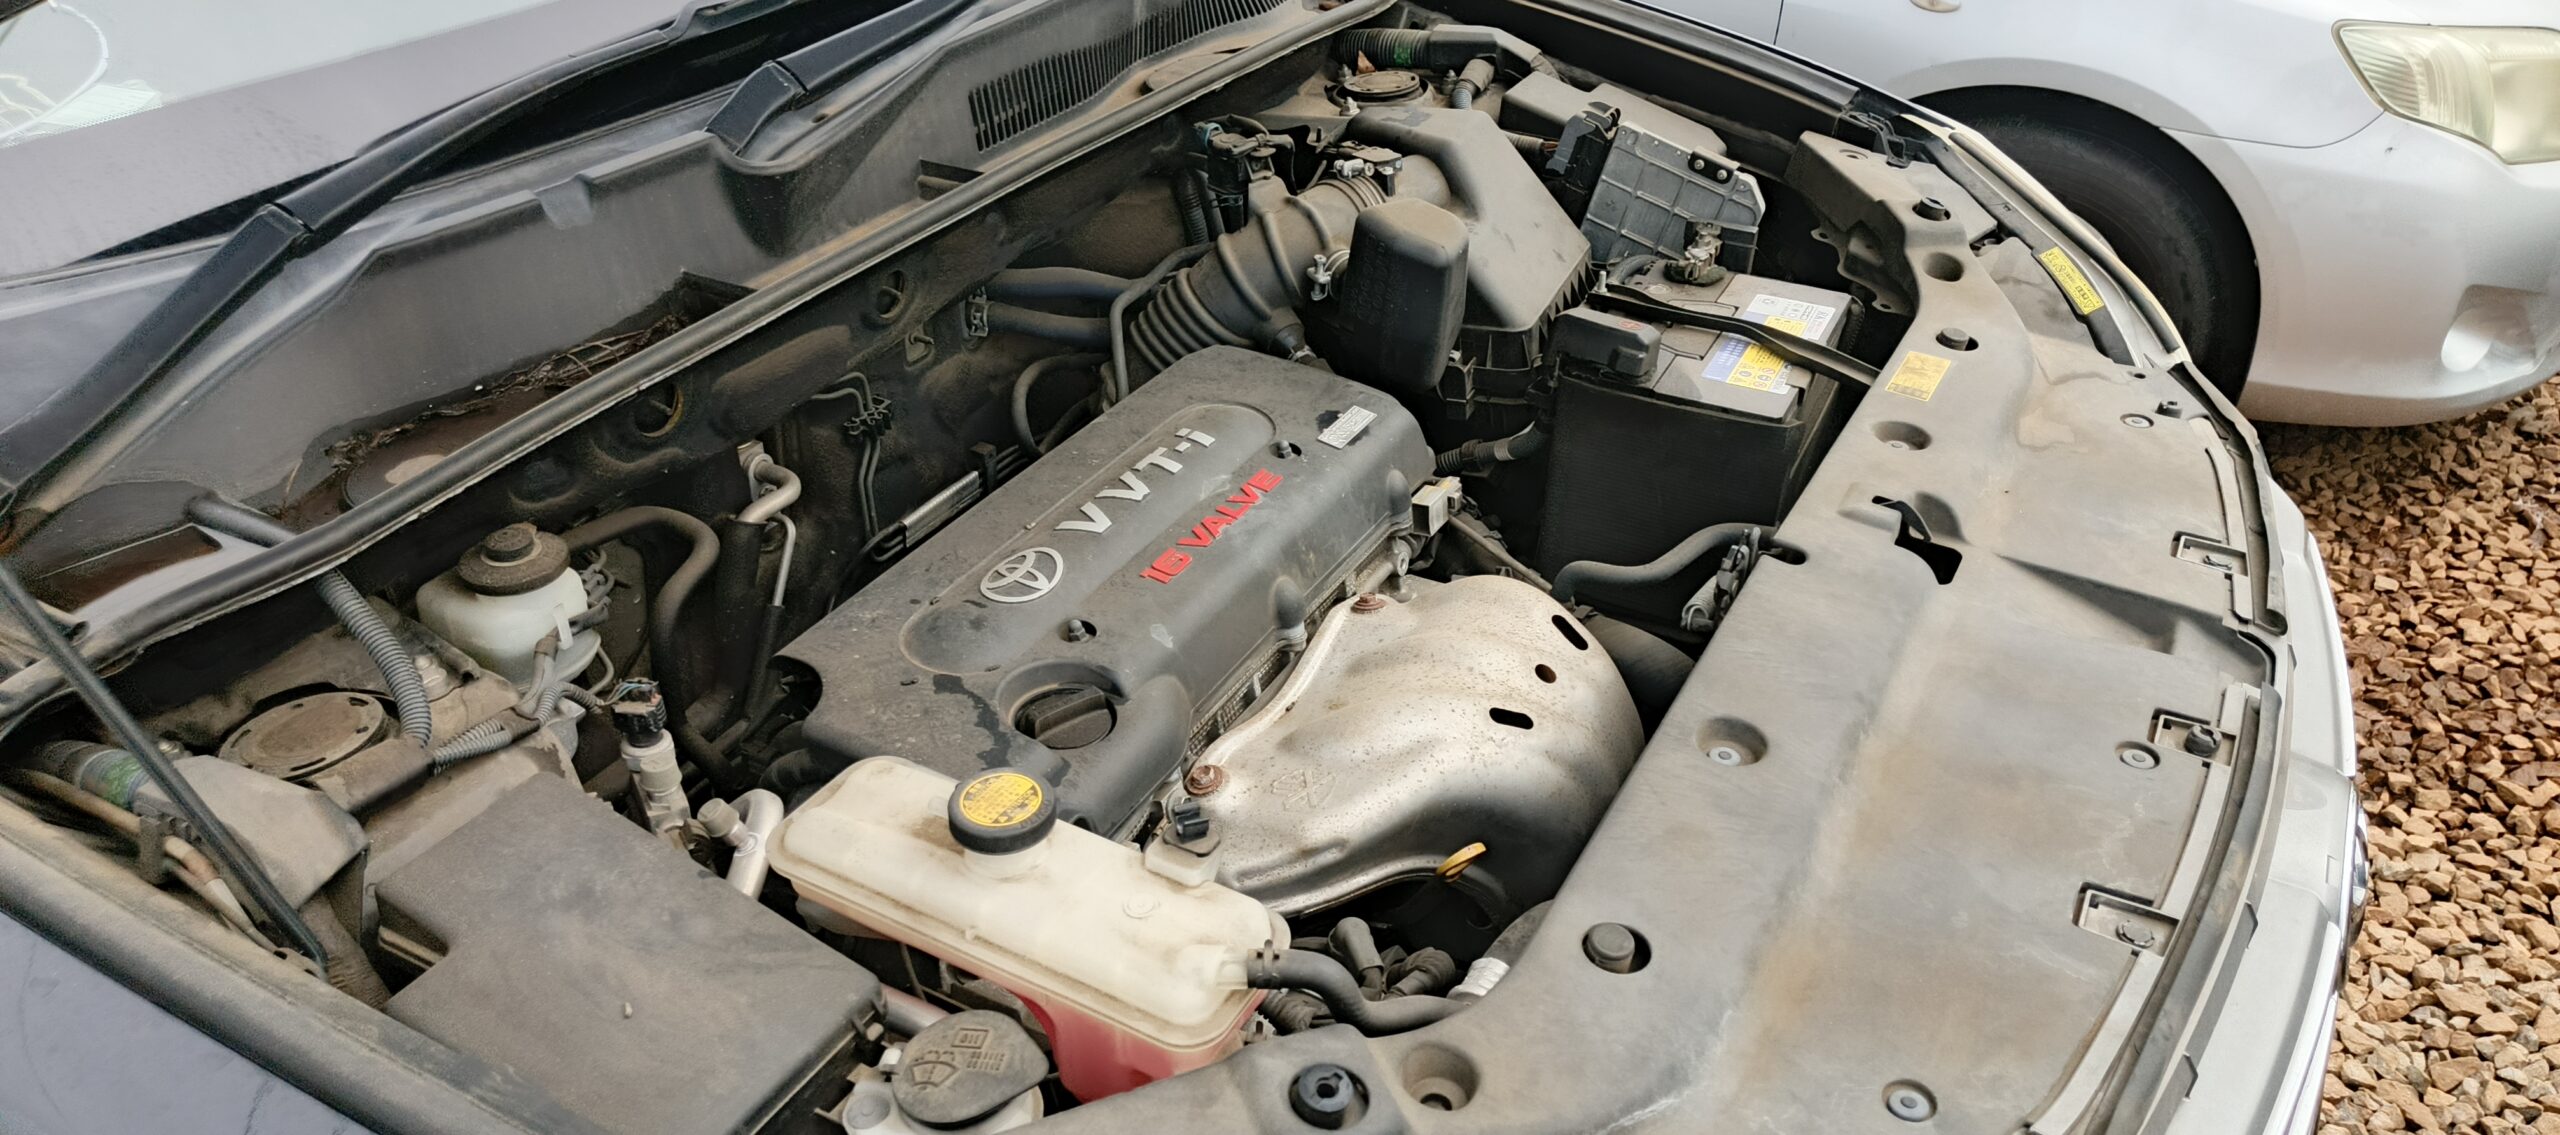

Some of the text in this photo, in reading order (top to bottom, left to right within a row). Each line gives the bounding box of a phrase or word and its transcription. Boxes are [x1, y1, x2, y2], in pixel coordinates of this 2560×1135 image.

[1054, 427, 1215, 533] VVT-i
[1139, 468, 1284, 584] 16 VALVE
